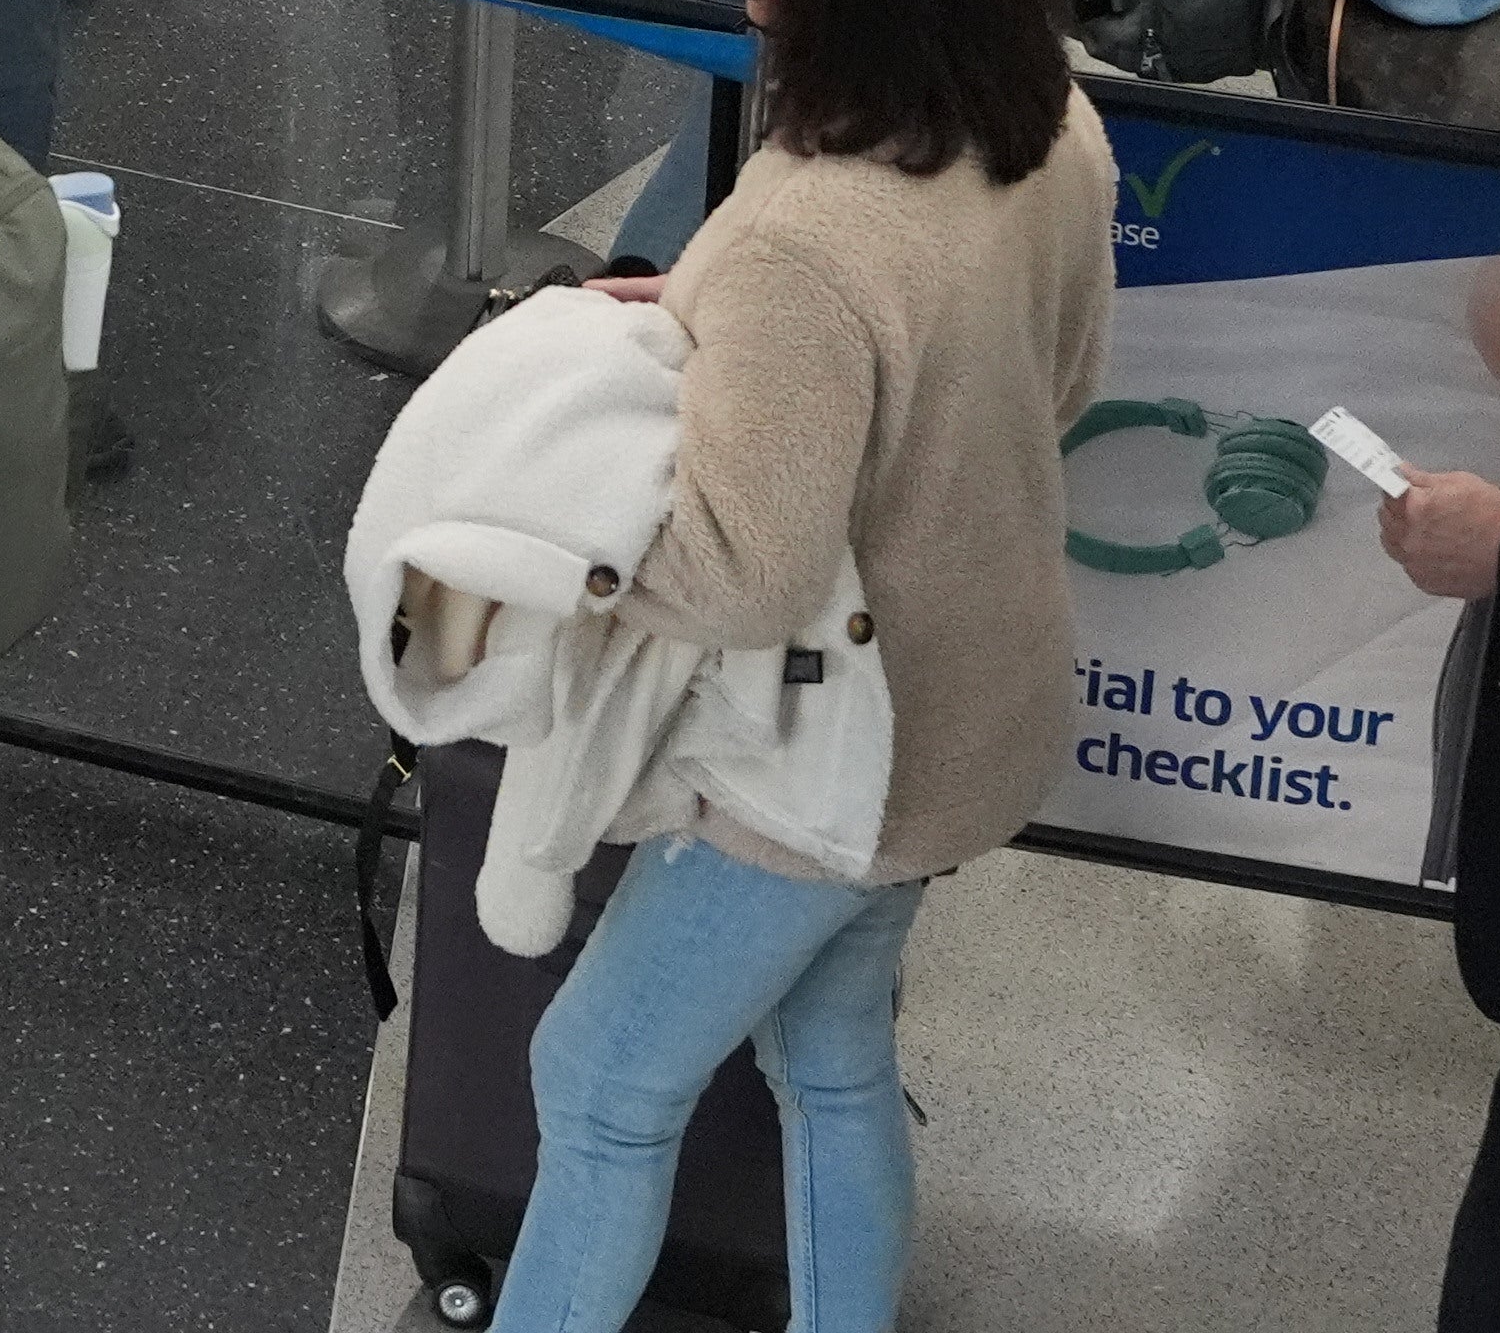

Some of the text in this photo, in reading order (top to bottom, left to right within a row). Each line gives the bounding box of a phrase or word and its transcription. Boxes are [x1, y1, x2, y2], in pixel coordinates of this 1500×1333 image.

[1173, 675, 1232, 726] to
[1250, 691, 1394, 746] your
[1076, 734, 1352, 810] checklist.
